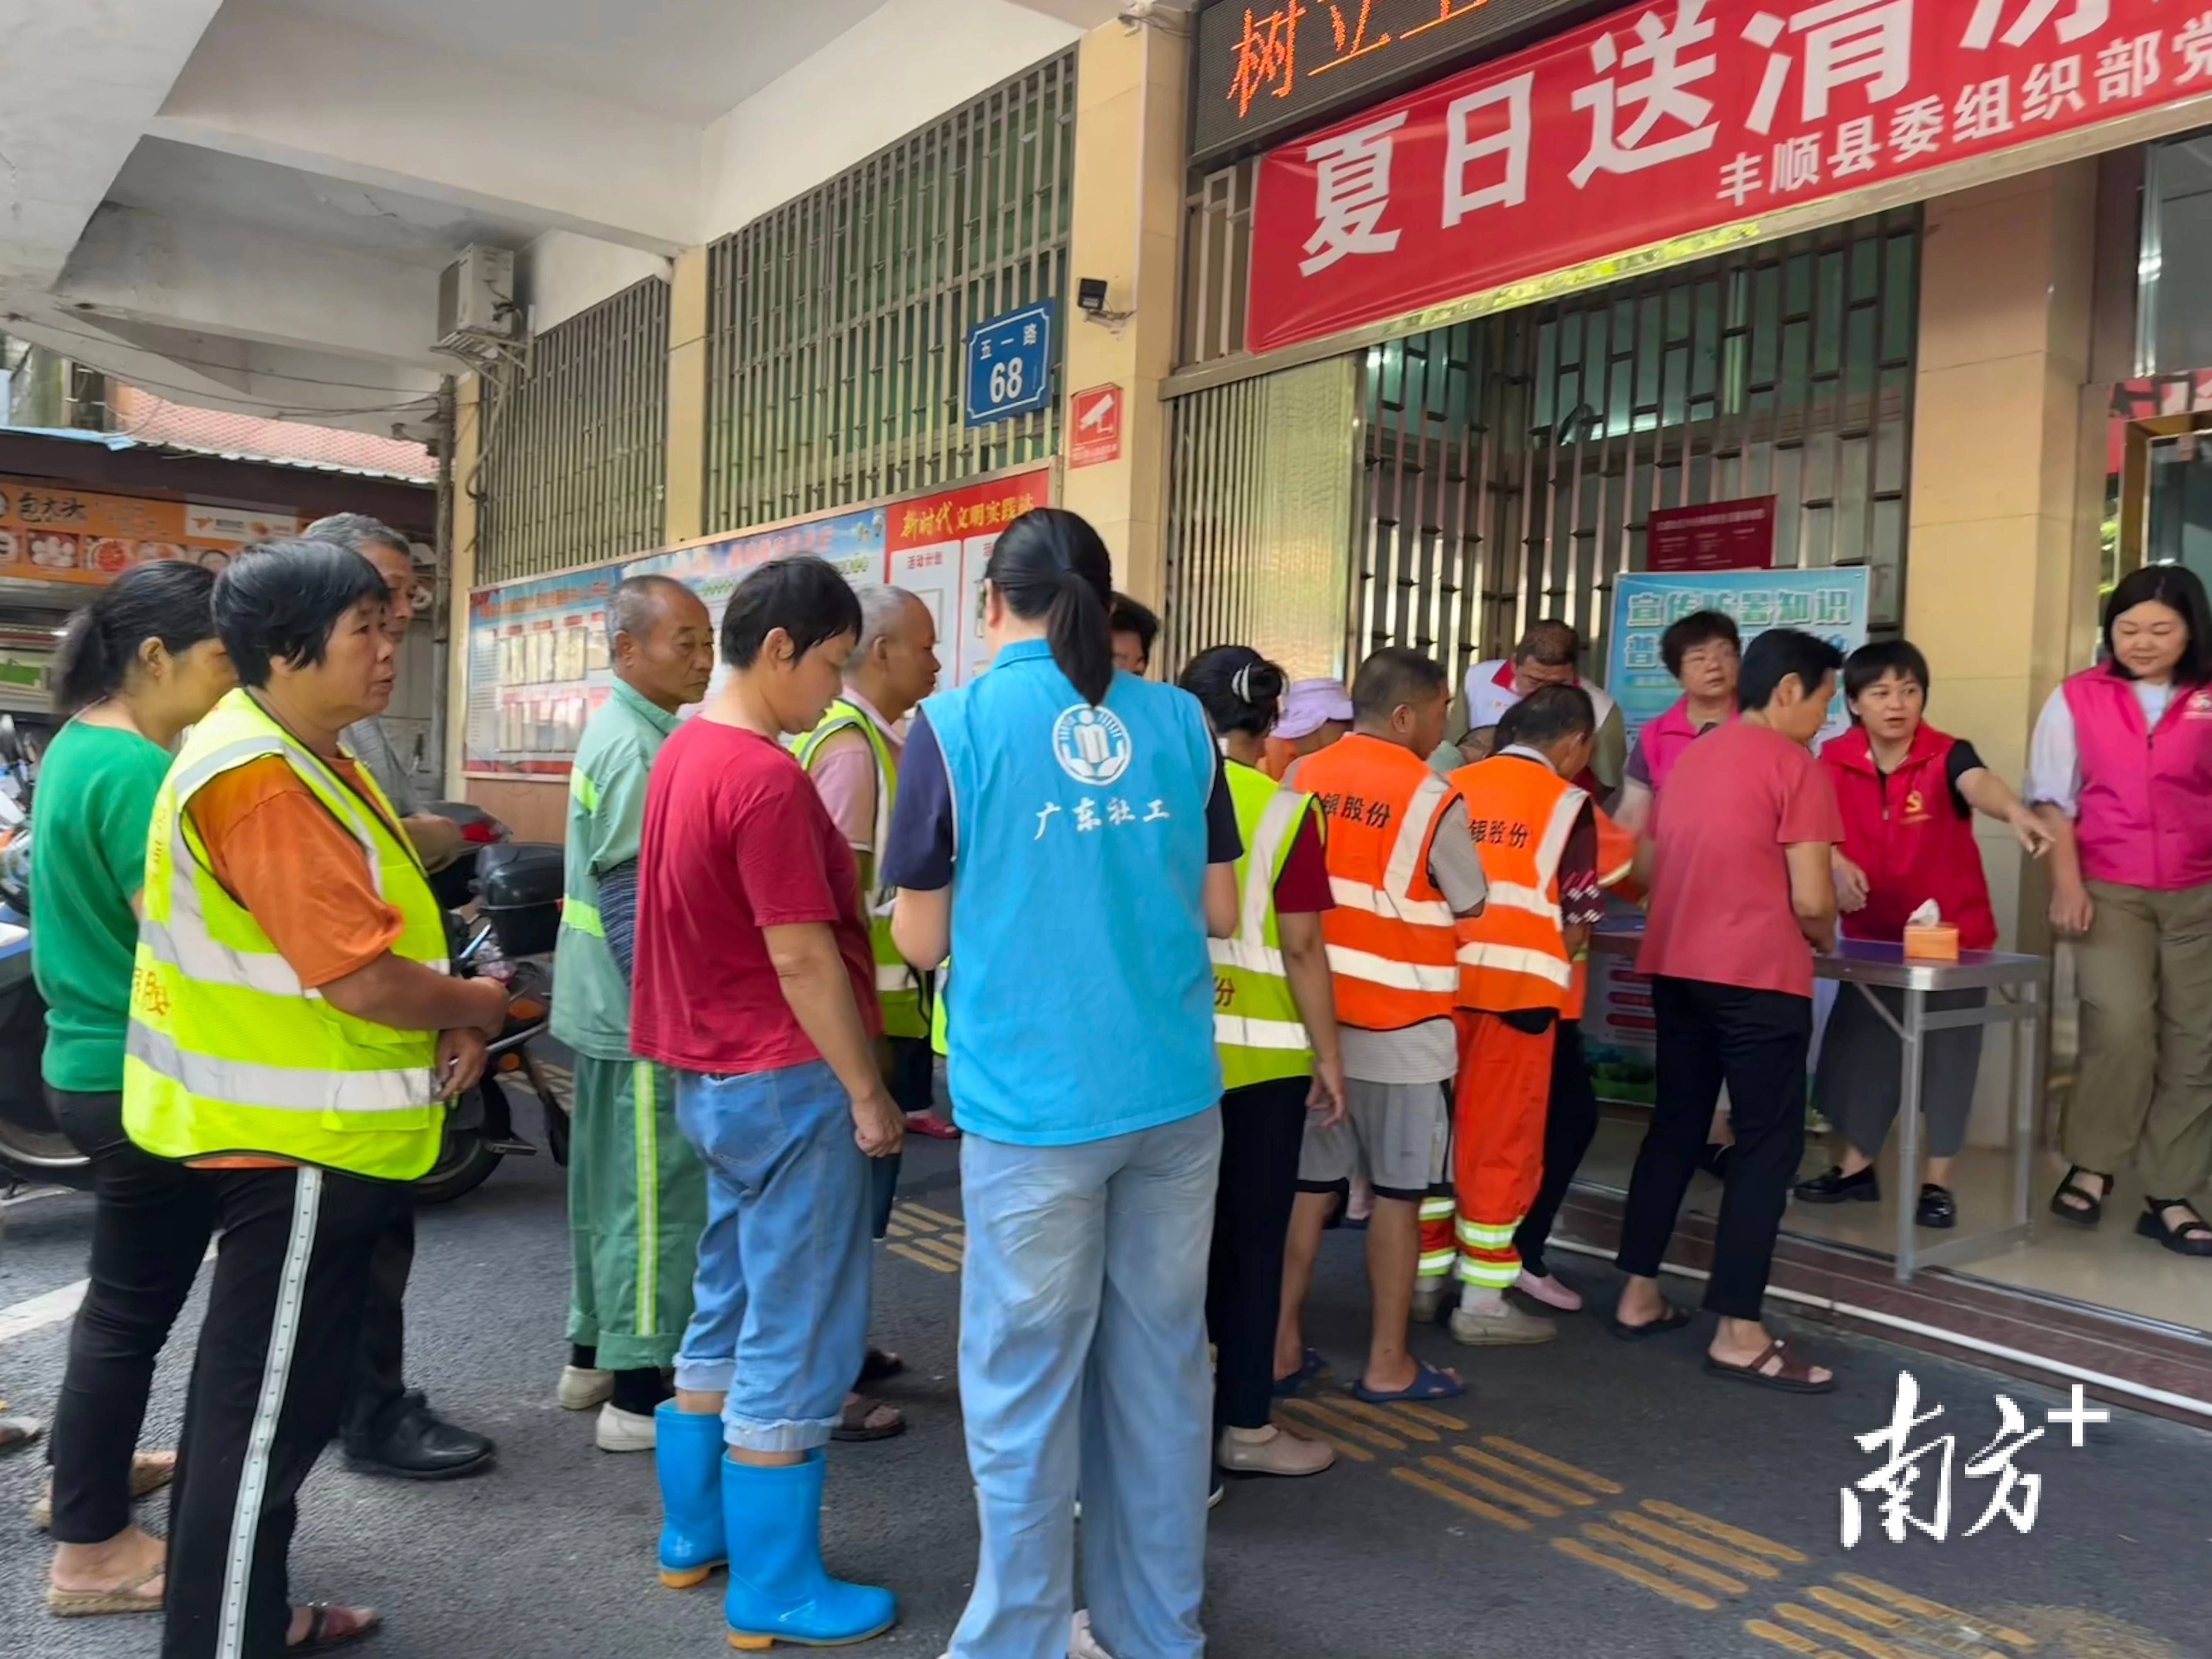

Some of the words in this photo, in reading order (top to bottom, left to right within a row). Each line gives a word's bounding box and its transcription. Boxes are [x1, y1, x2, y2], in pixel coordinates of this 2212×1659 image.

[1226, 0, 1490, 119] 树立
[980, 323, 1037, 360] 五一路
[990, 357, 1023, 403] 68
[1034, 797, 1170, 840] 广东社工
